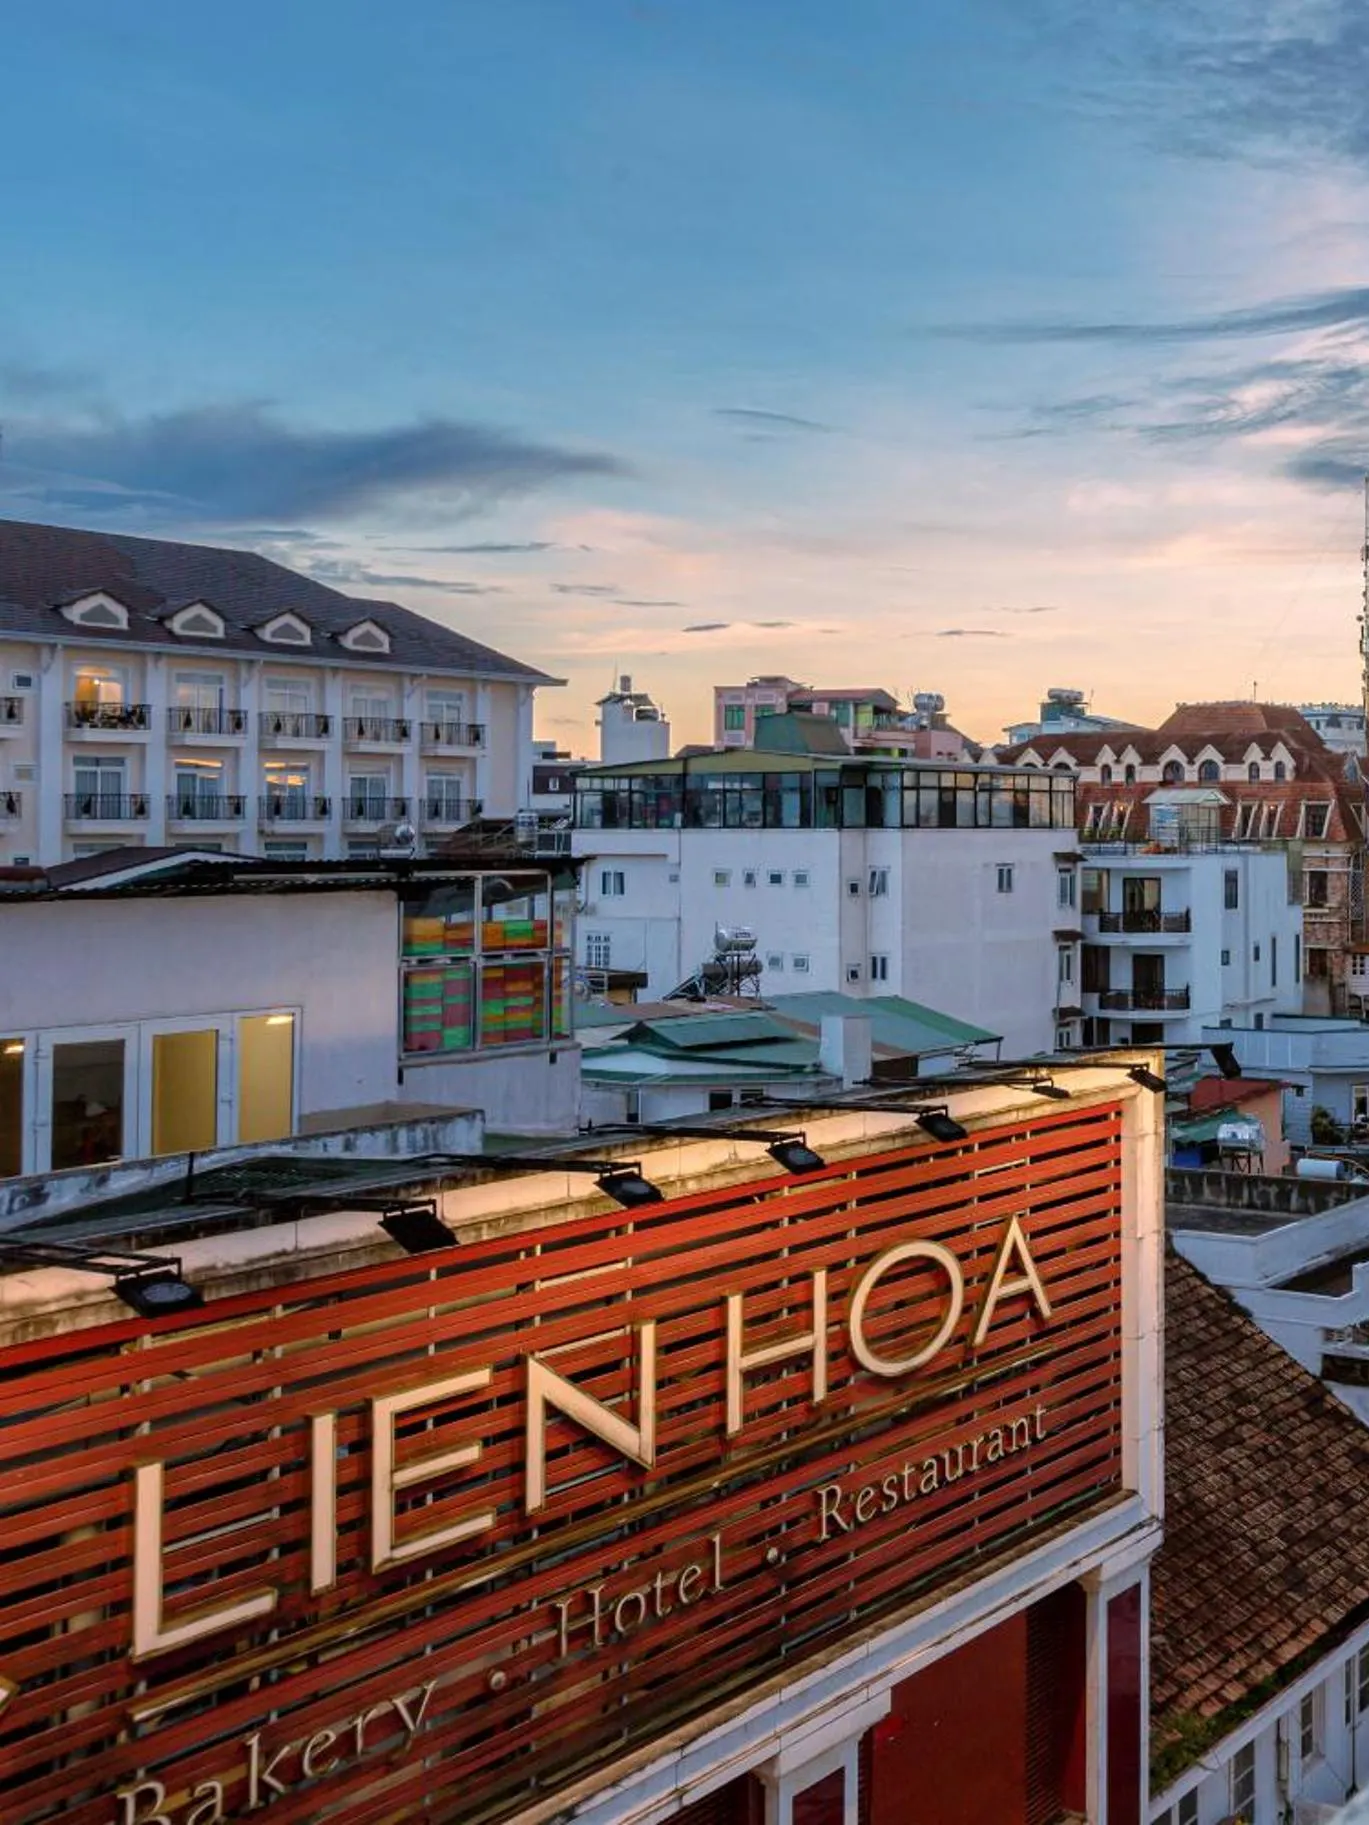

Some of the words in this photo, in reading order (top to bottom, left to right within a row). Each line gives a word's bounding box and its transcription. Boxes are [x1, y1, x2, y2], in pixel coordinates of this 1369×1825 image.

[116, 1678, 439, 1825] Bakery
[554, 1531, 725, 1659] Hotel
[817, 1402, 1048, 1542] Restaurant
[132, 1318, 656, 1663] LIEN
[727, 1214, 1053, 1438] HOA
